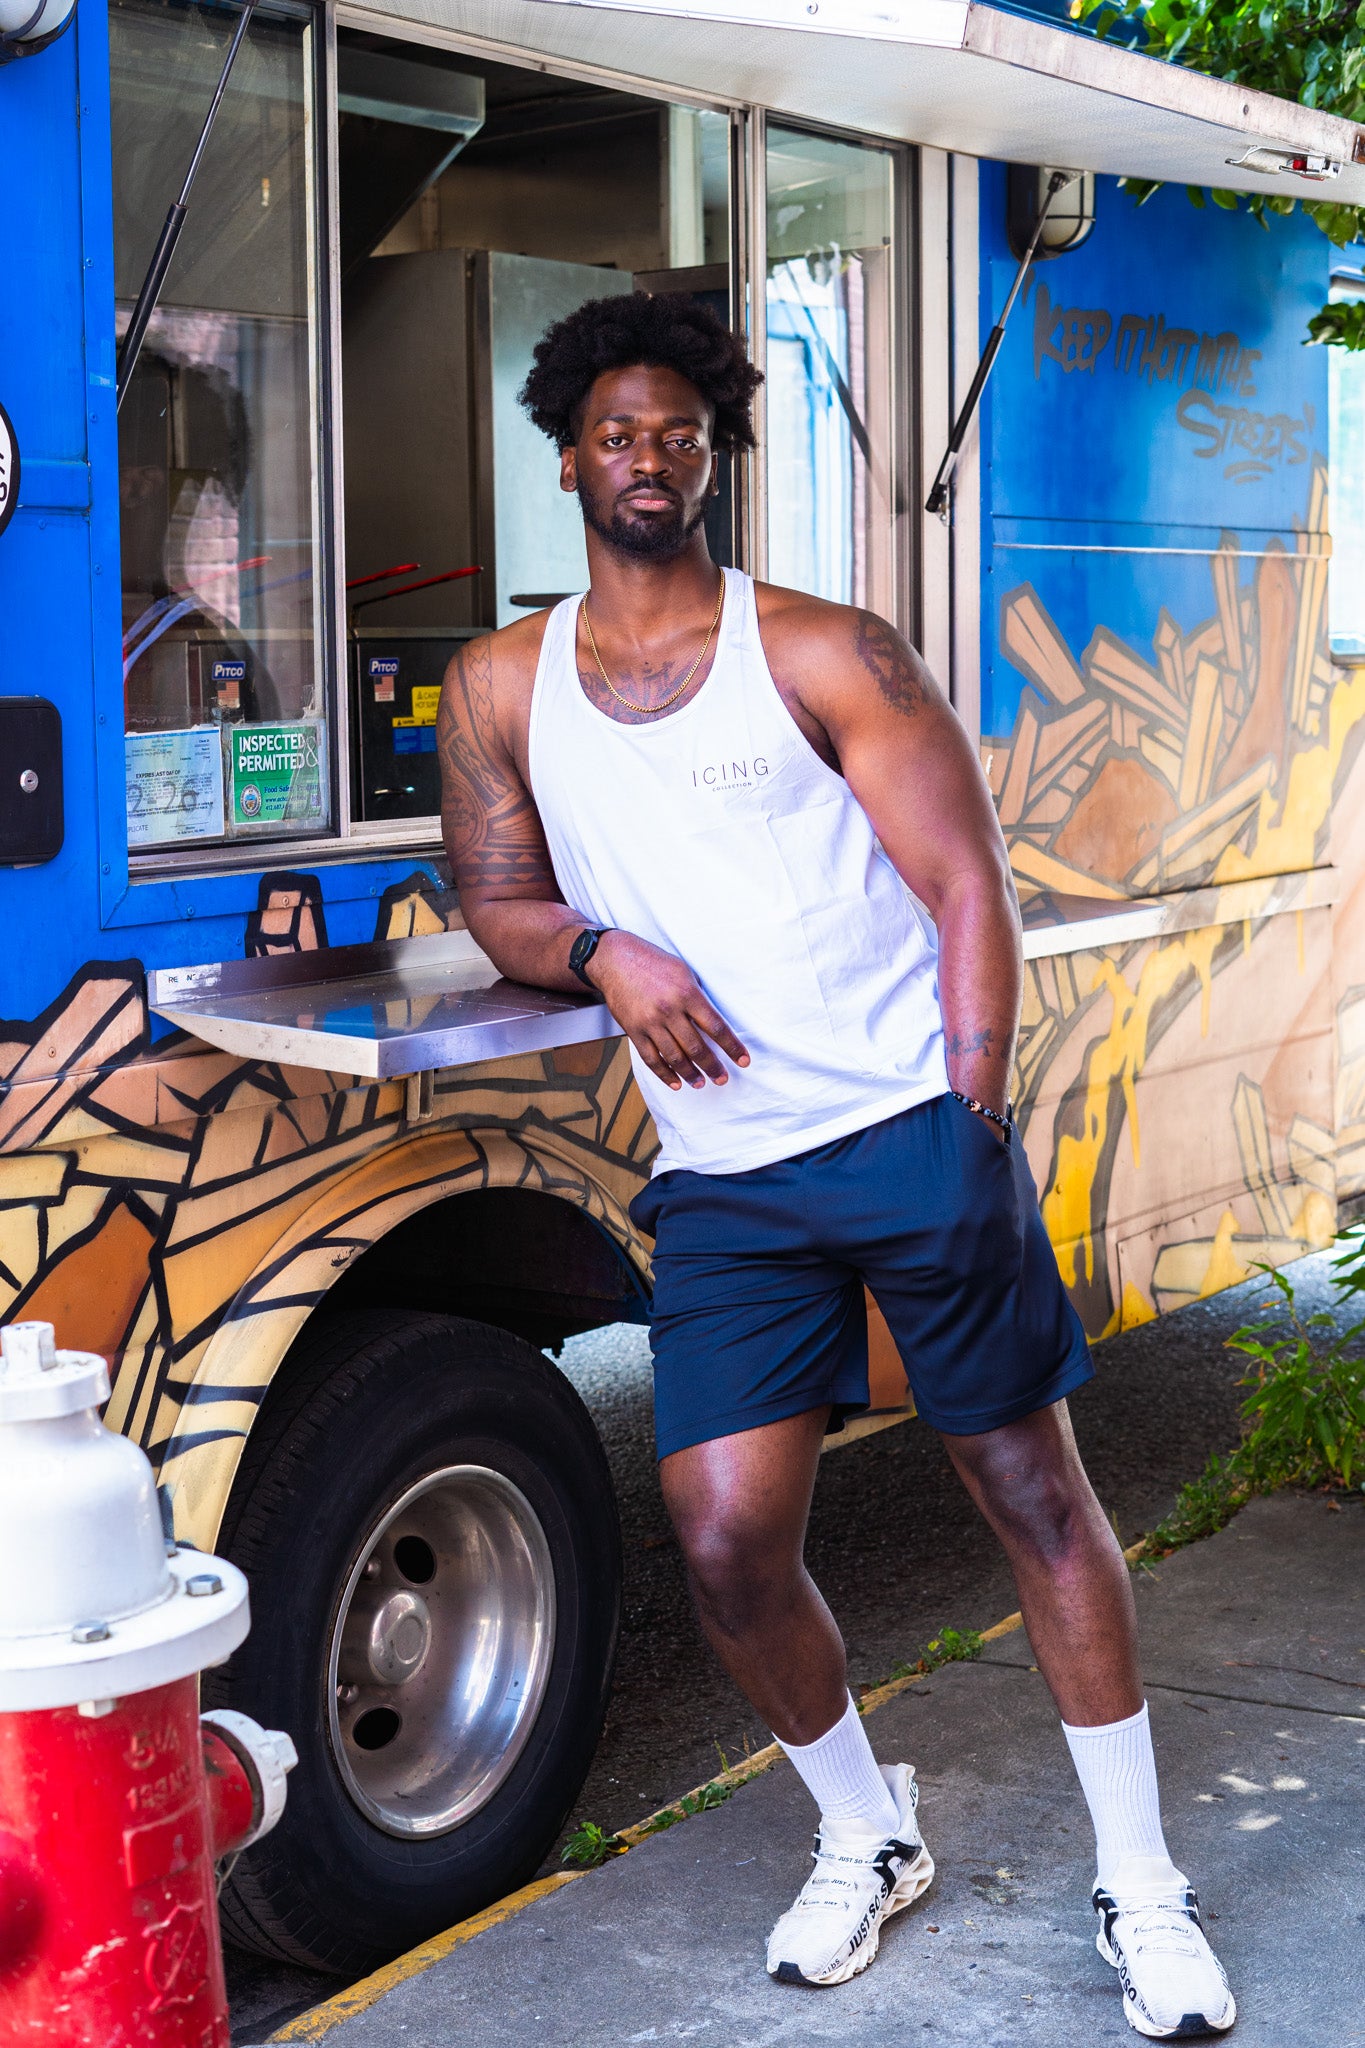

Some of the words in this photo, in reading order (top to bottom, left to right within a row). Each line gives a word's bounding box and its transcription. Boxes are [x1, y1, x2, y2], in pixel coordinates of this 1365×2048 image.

[239, 733, 305, 752] INSPECTED
[239, 752, 306, 773] PERMITTED
[692, 757, 769, 787] ICING
[712, 782, 752, 792] COLLECTION
[848, 1913, 870, 1957] JUST
[868, 1894, 881, 1919] SO
[881, 1881, 888, 1899] S
[1123, 1978, 1137, 2002] SO
